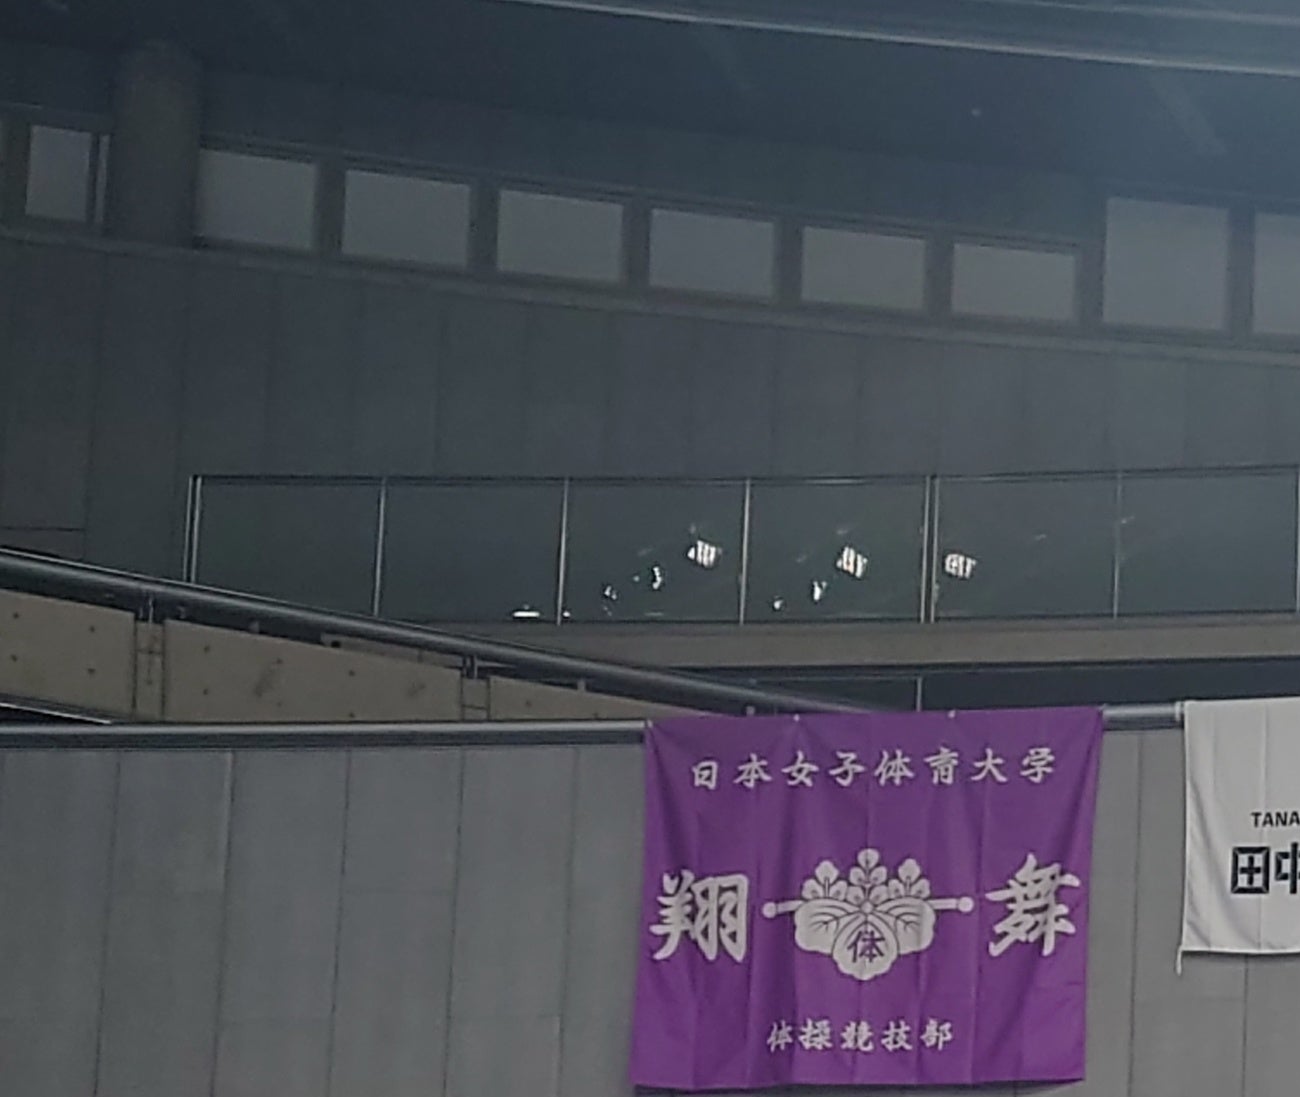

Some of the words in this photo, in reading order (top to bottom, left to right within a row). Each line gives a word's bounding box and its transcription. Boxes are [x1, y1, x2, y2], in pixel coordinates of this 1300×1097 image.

[691, 747, 1056, 789] 日本女子体育大学
[649, 869, 750, 963] 翔
[985, 852, 1081, 958] 舞
[767, 1017, 953, 1053] 体操競技部
